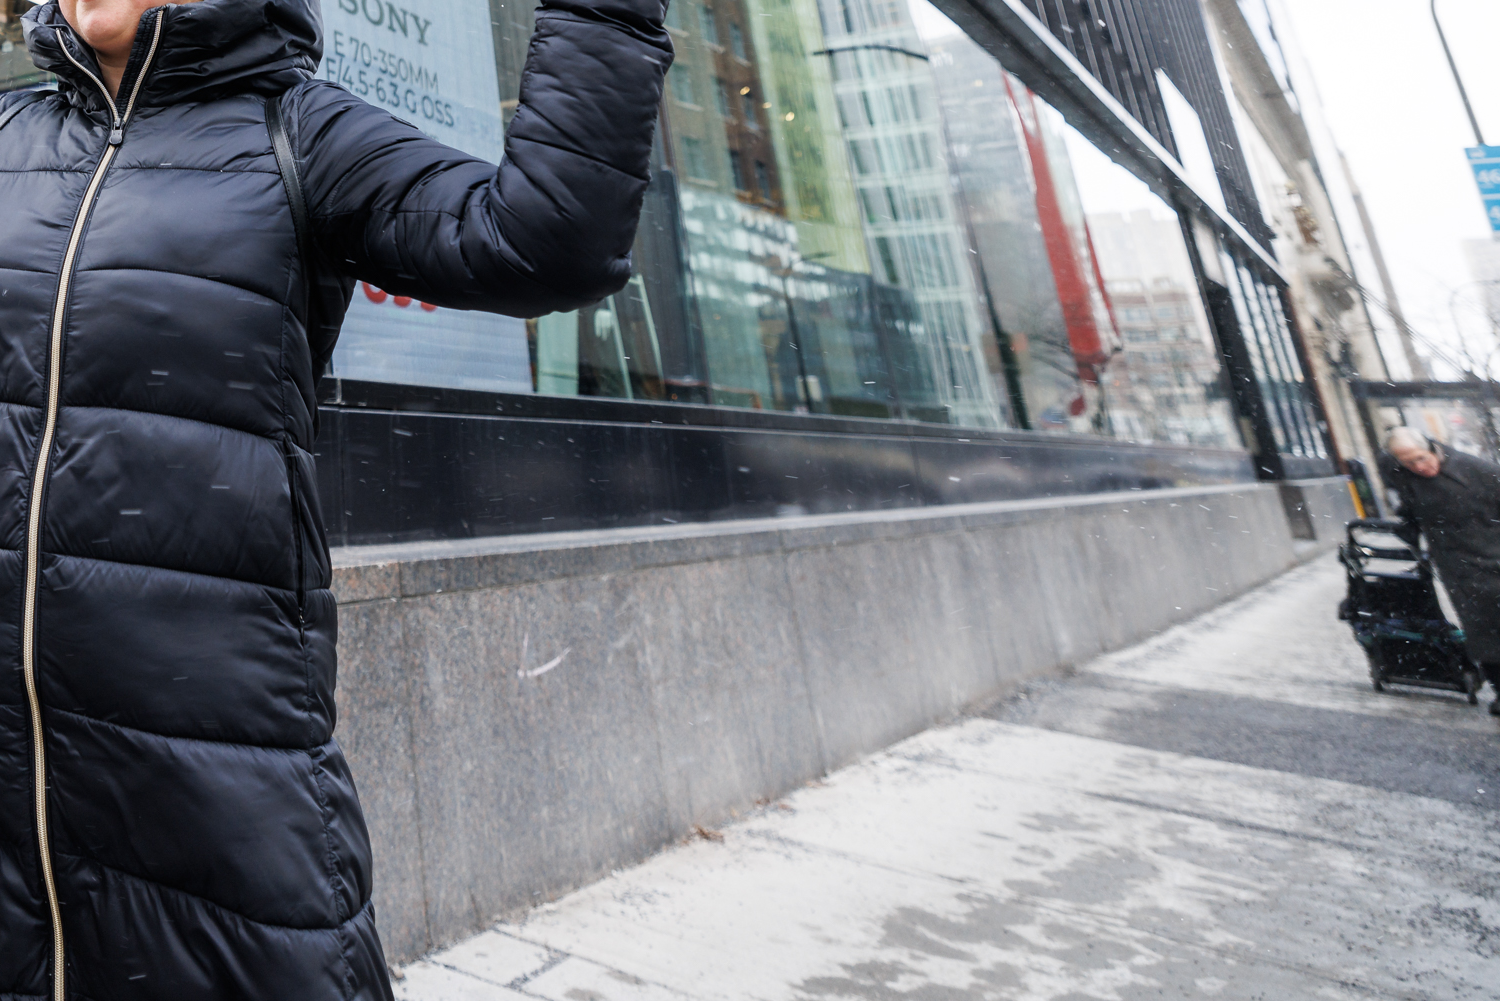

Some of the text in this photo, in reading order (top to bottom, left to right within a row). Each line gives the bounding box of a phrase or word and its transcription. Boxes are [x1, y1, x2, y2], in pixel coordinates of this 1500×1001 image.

[326, 56, 456, 128] F/4.5-6.3 G OSS
[333, 30, 440, 96] E 70-350MM
